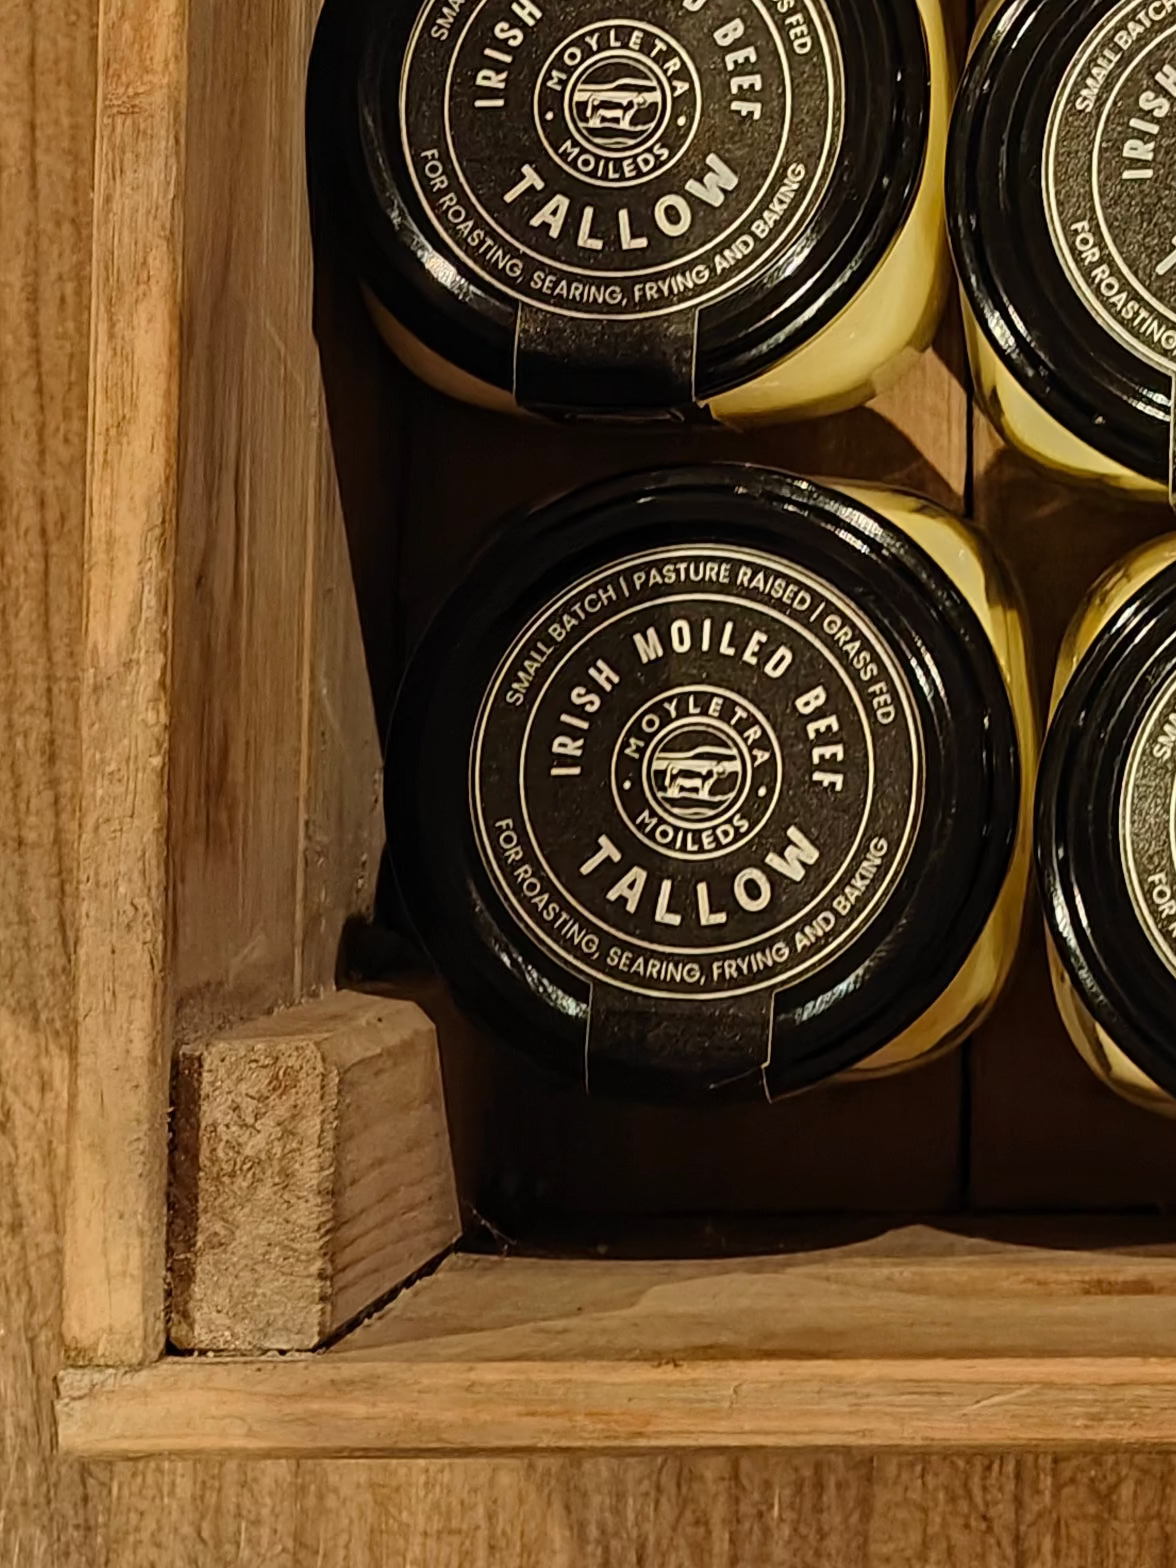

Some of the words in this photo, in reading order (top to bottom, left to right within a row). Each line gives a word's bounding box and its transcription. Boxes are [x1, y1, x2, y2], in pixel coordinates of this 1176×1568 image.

[546, 28, 690, 98] MOYLETRA
[713, 18, 762, 120] BEEF
[785, 13, 813, 55] FED
[1075, 49, 1121, 113] SMALL
[504, 152, 738, 250] TALLOW
[558, 138, 669, 179] MOILEDS
[421, 148, 449, 193] FOR
[439, 192, 524, 283] ROASTING,
[530, 270, 627, 307] SEARING,
[633, 263, 709, 303] FRYING
[713, 234, 754, 275] AND
[750, 163, 805, 240] BAKING
[1070, 221, 1100, 266] FOR
[505, 641, 555, 706] SMALL
[547, 584, 617, 642] BATCH
[633, 561, 731, 590] PASTURE
[736, 565, 811, 611] RAISED
[822, 614, 878, 681] GRASS
[867, 681, 895, 724] FED
[550, 658, 620, 776] IRISH
[633, 618, 793, 678] MOILED
[794, 685, 844, 791] BEEF
[624, 694, 771, 768] MOYLETRA
[635, 809, 749, 851] MOILEDS
[495, 818, 523, 864] FOR
[513, 863, 599, 960] ROASTING,
[606, 946, 706, 986] SEARING,
[712, 940, 790, 982] FRYING
[794, 910, 835, 953] AND
[832, 836, 888, 916] BAKING
[579, 825, 820, 926] TALLOW
